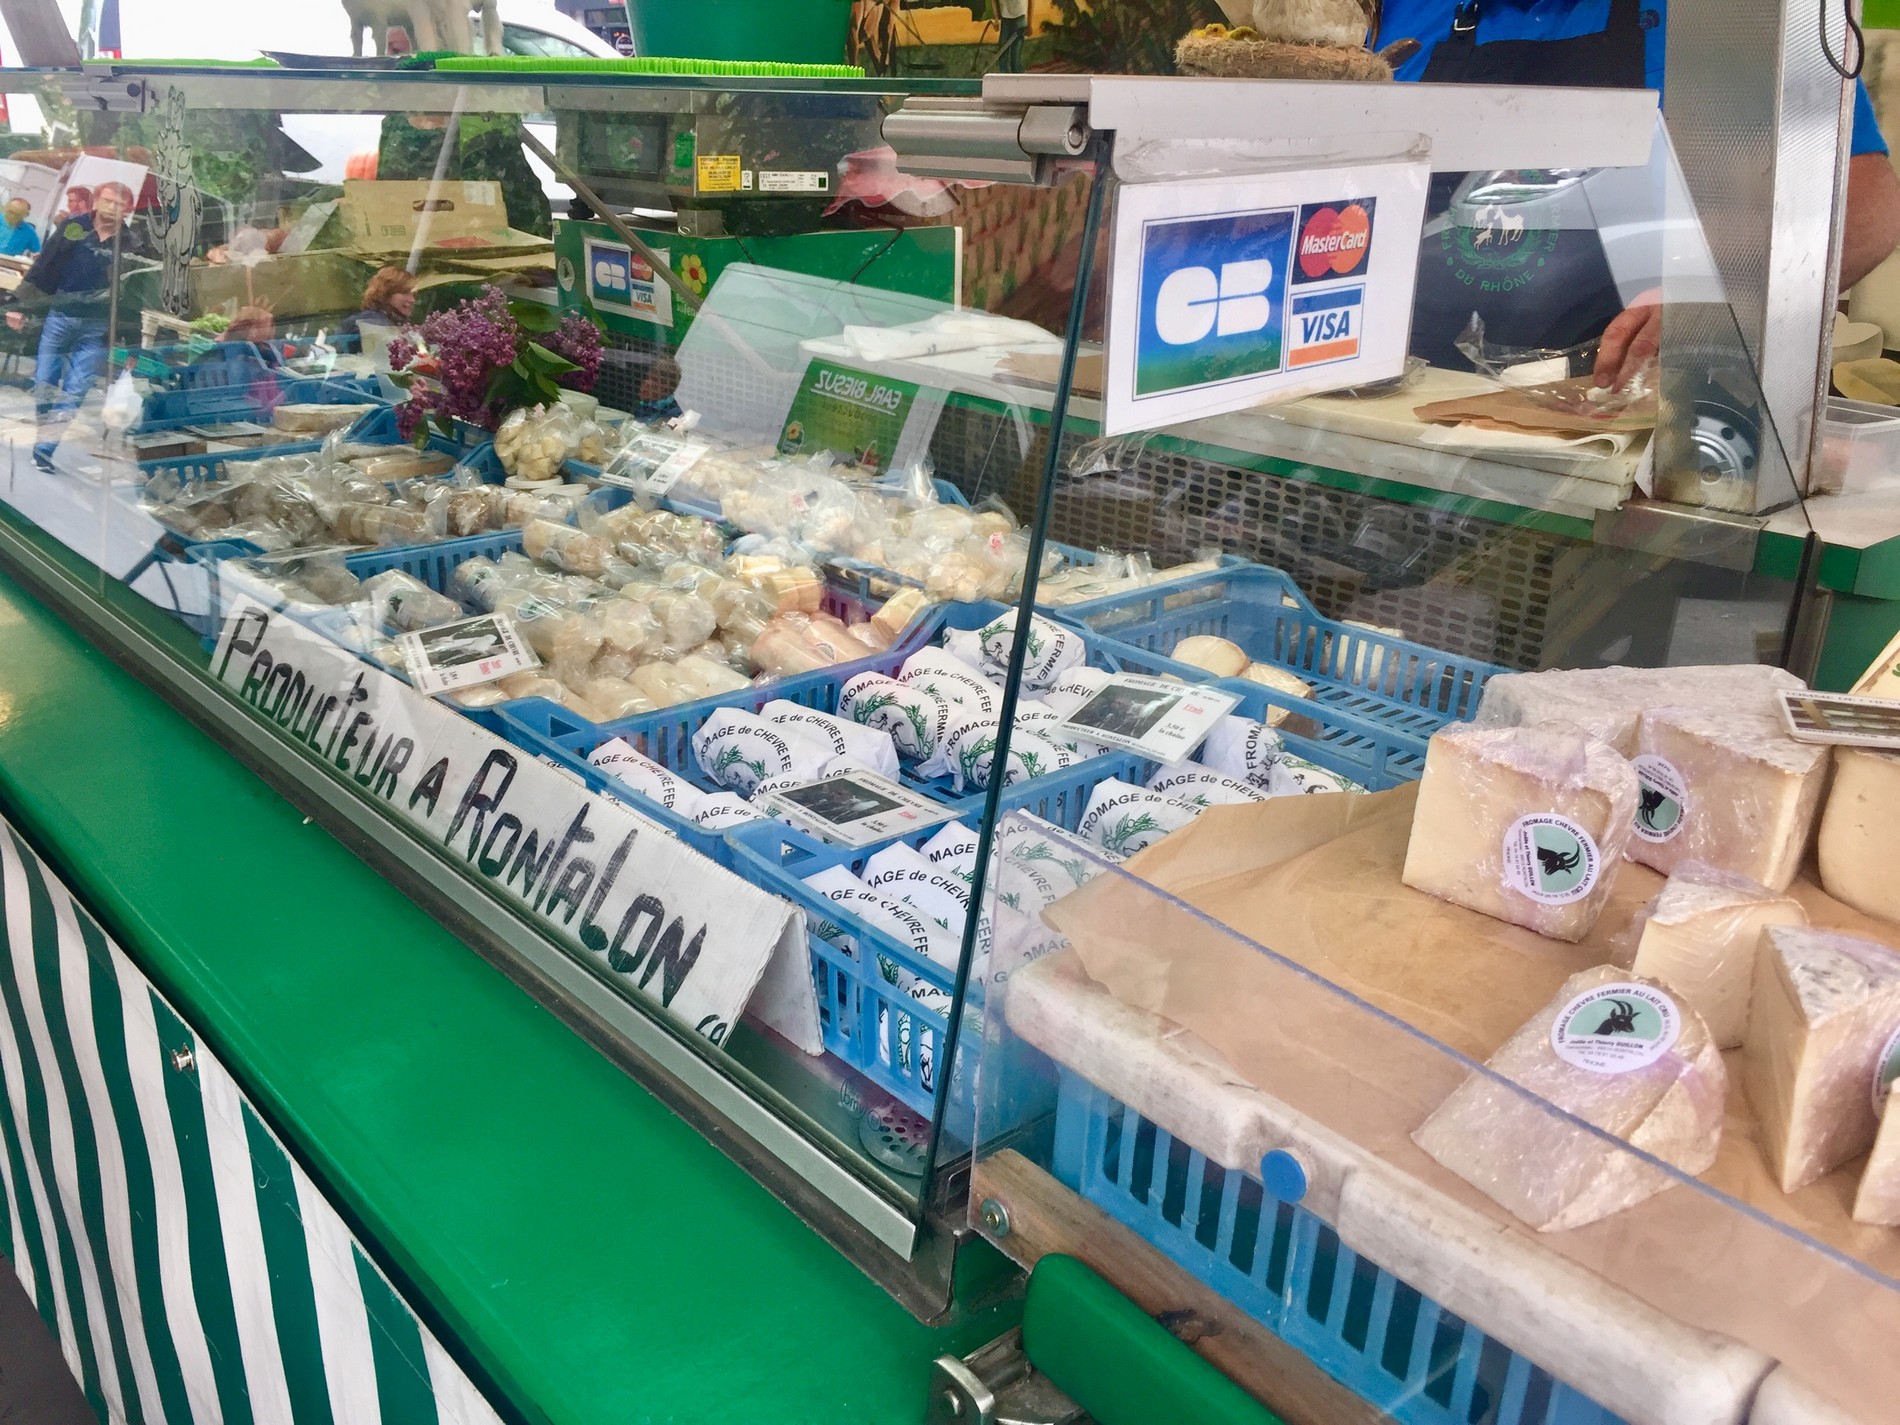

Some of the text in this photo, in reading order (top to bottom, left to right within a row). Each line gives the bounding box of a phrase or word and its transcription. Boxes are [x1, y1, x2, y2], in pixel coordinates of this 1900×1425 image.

[1301, 229, 1367, 255] MasterCard
[595, 261, 627, 291] CB
[635, 292, 653, 304] VISA
[1155, 258, 1273, 345] CB
[1301, 311, 1350, 344] VISA
[840, 680, 895, 712] FROMAGE
[950, 673, 987, 696] CHEVRE
[789, 714, 803, 722] de
[805, 716, 841, 739] CHEVRE
[738, 725, 752, 735] de
[754, 728, 789, 756] CHEVRE
[640, 761, 671, 787] CHEVRE
[1200, 774, 1217, 784] de
[408, 756, 449, 818] A
[734, 807, 751, 816] de
[1080, 792, 1141, 840] FROMAGE
[1145, 793, 1162, 803] de
[1522, 817, 1553, 827] FROMAGE
[1554, 819, 1580, 837] CHEVRE
[929, 843, 976, 863] MAGE
[1578, 835, 1594, 862] FERMIER
[909, 869, 928, 882] de
[1582, 873, 1594, 887] LAIT
[1587, 863, 1594, 873] AU
[1571, 885, 1584, 896] CRU
[858, 890, 877, 902] de
[880, 900, 926, 936] CHEVRE
[1558, 988, 1670, 1044] FROMAGE CHEVRE FERMIER AU LAIT CRU
